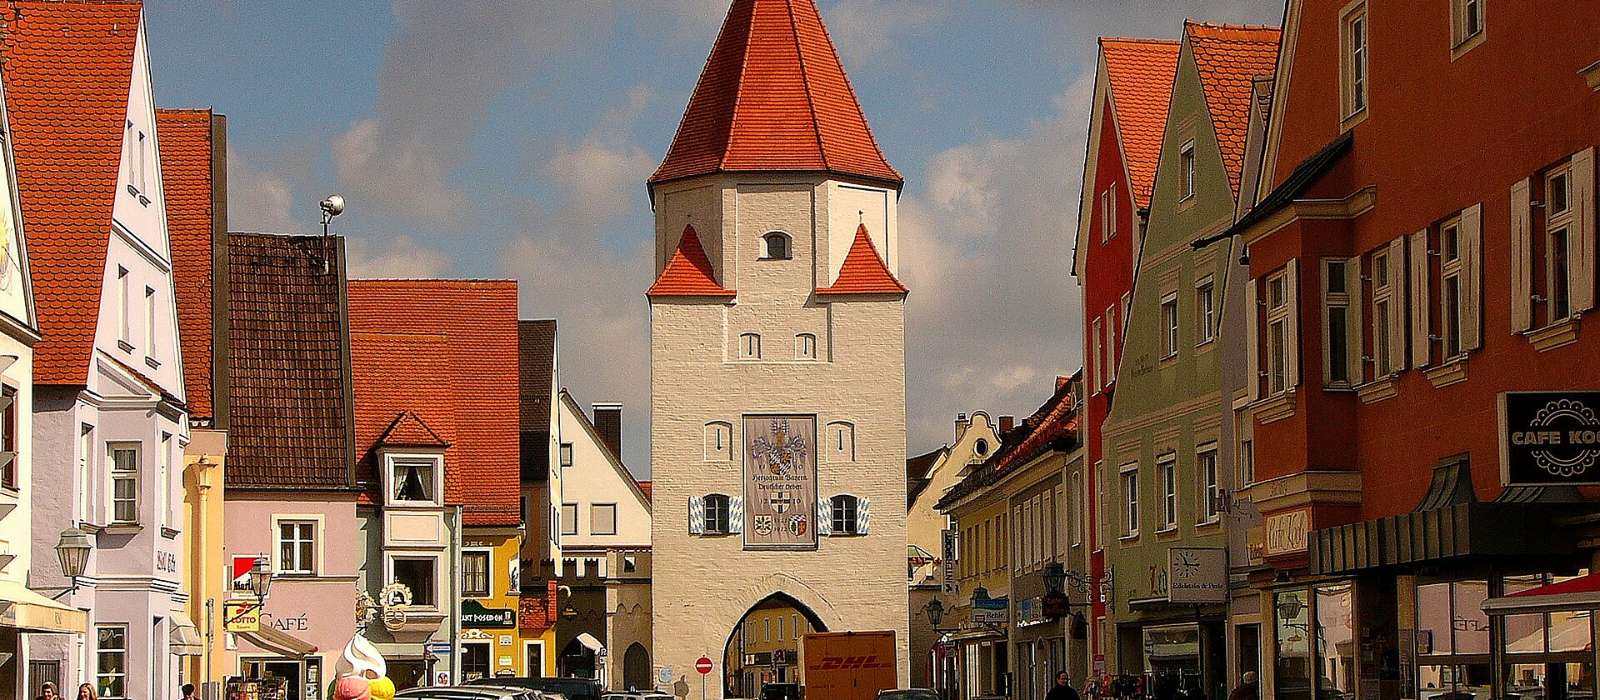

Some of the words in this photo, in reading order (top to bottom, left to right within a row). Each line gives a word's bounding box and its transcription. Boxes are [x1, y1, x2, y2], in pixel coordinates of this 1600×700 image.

[1512, 431, 1560, 445] CAFE
[1569, 431, 1600, 445] KO
[821, 655, 881, 669] DHL
